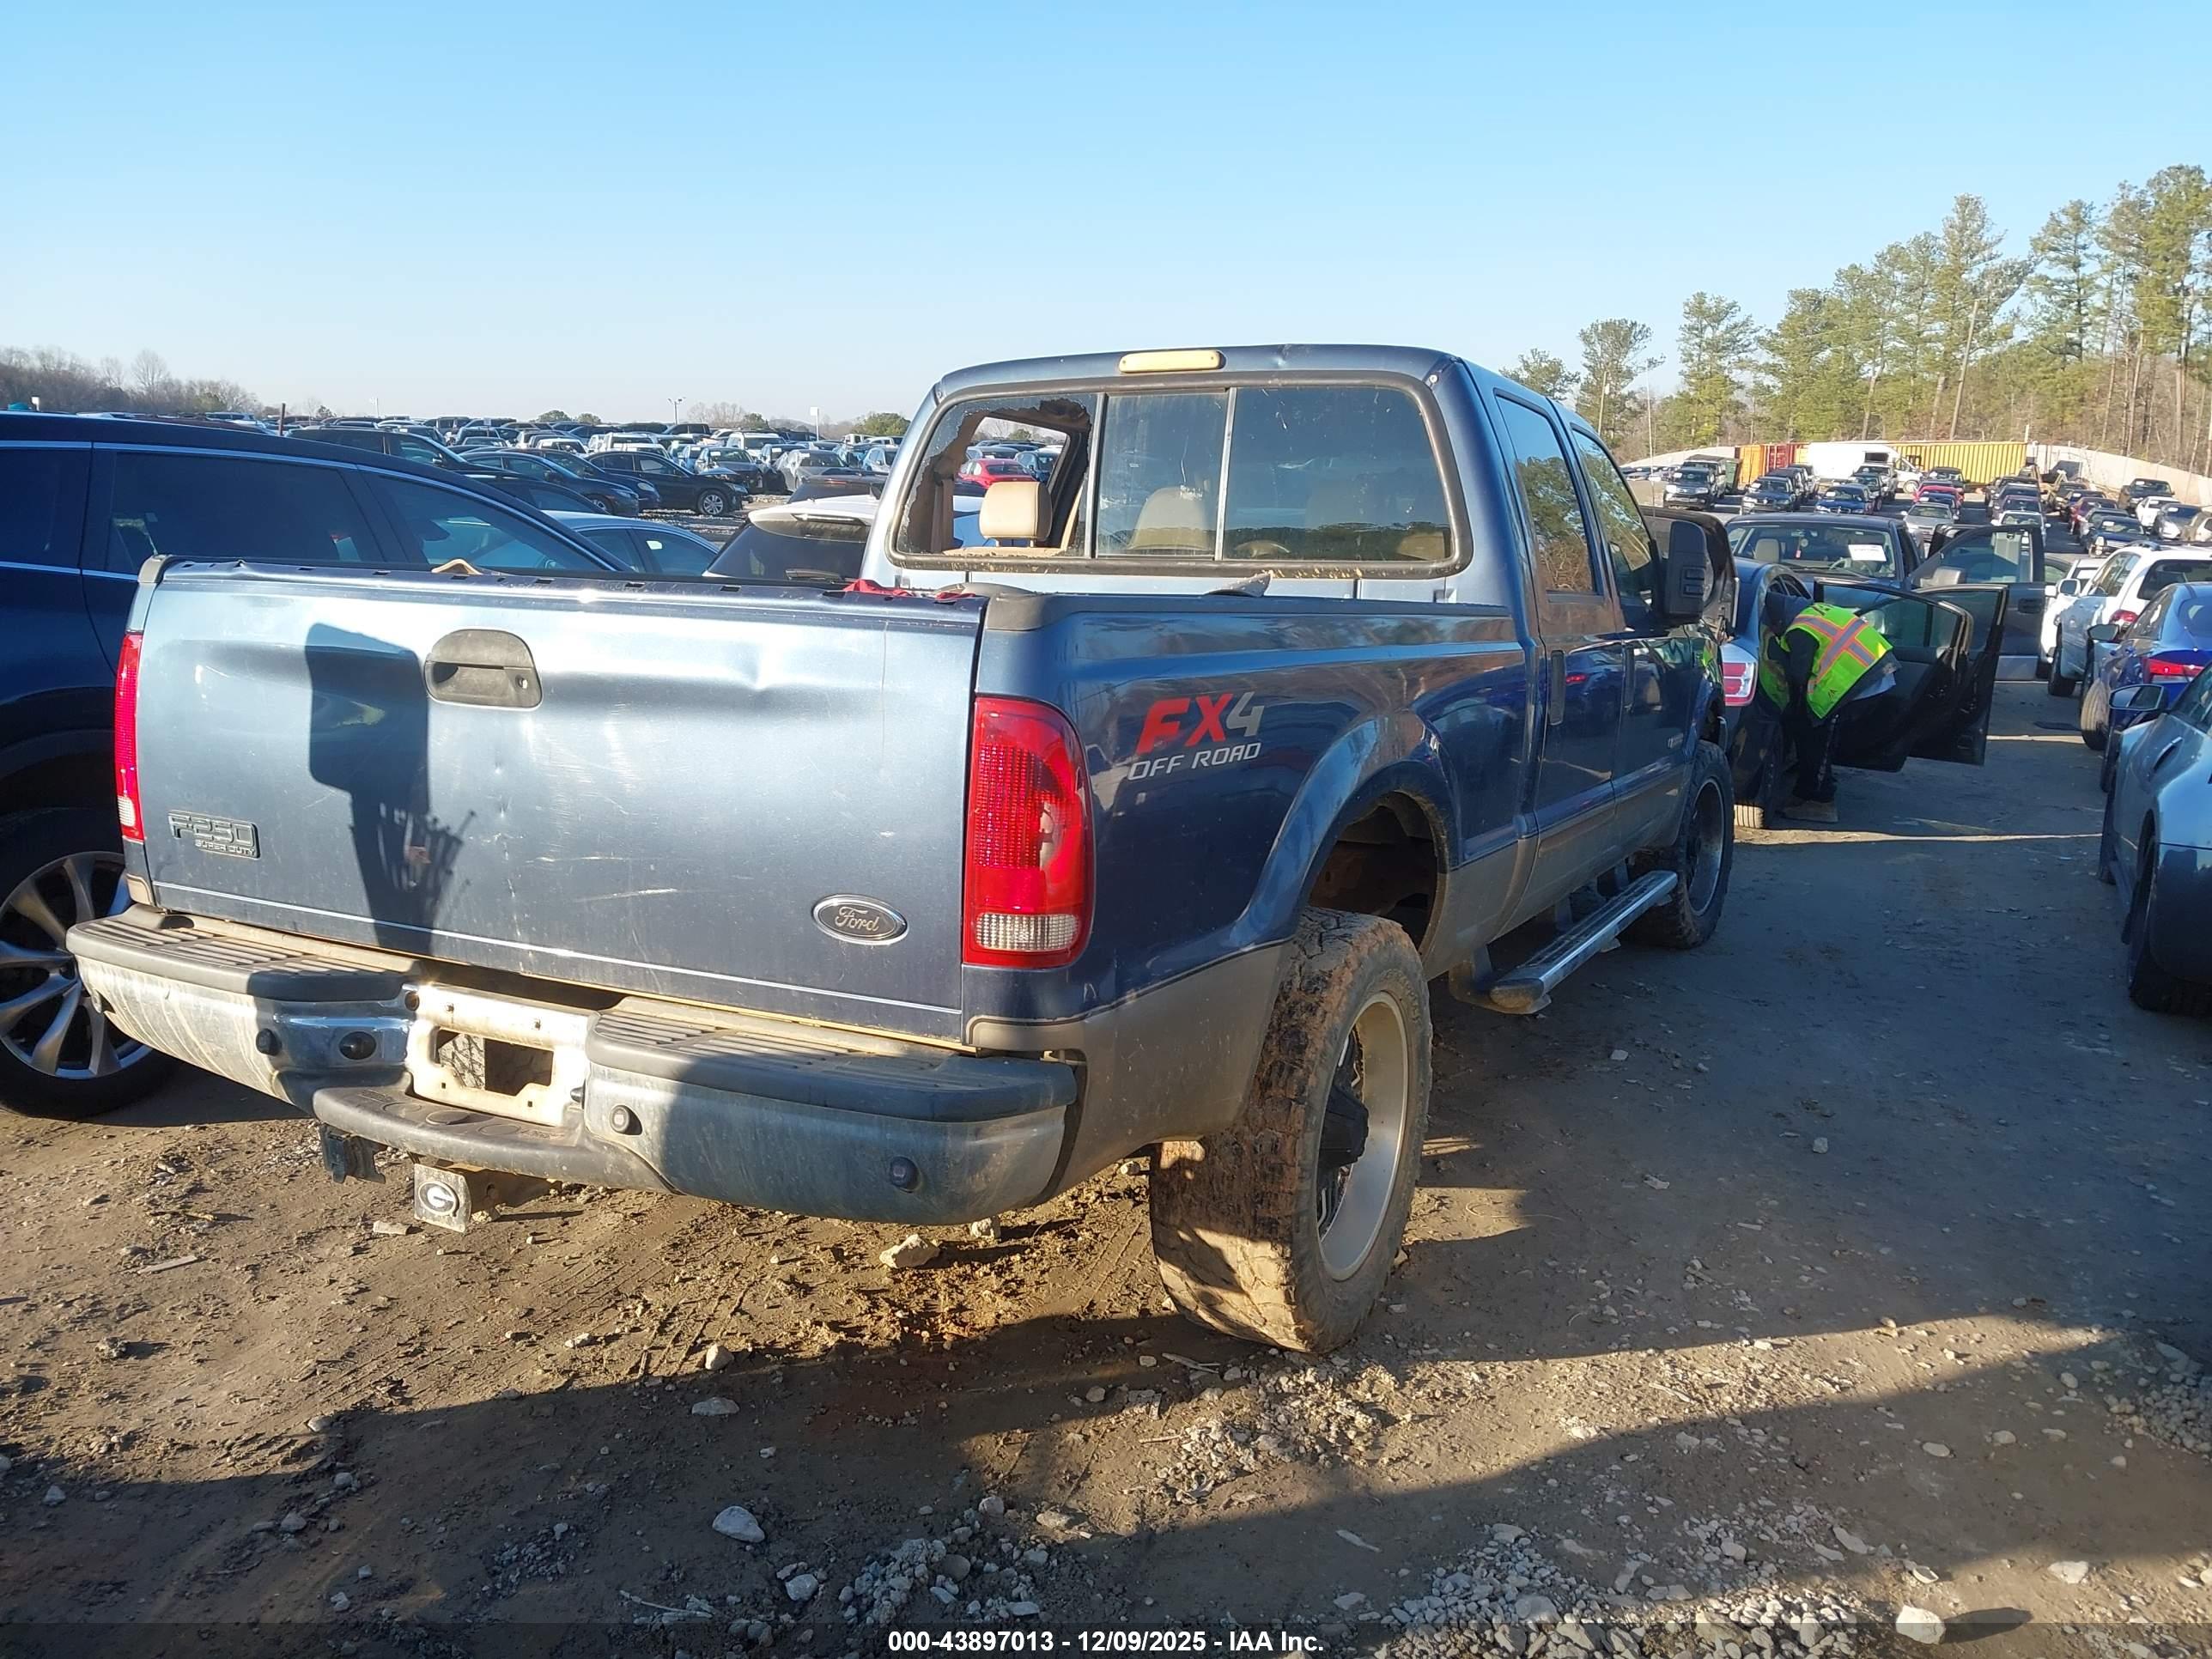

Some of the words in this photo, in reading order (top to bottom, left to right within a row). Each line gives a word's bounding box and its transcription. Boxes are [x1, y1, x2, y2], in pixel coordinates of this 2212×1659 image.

[1134, 690, 1266, 757] FX4
[1127, 754, 1186, 781] OFF
[1190, 742, 1262, 769] ROAD
[194, 839, 228, 851] SUPER
[228, 845, 256, 856] DUTY
[834, 906, 880, 932] Ford
